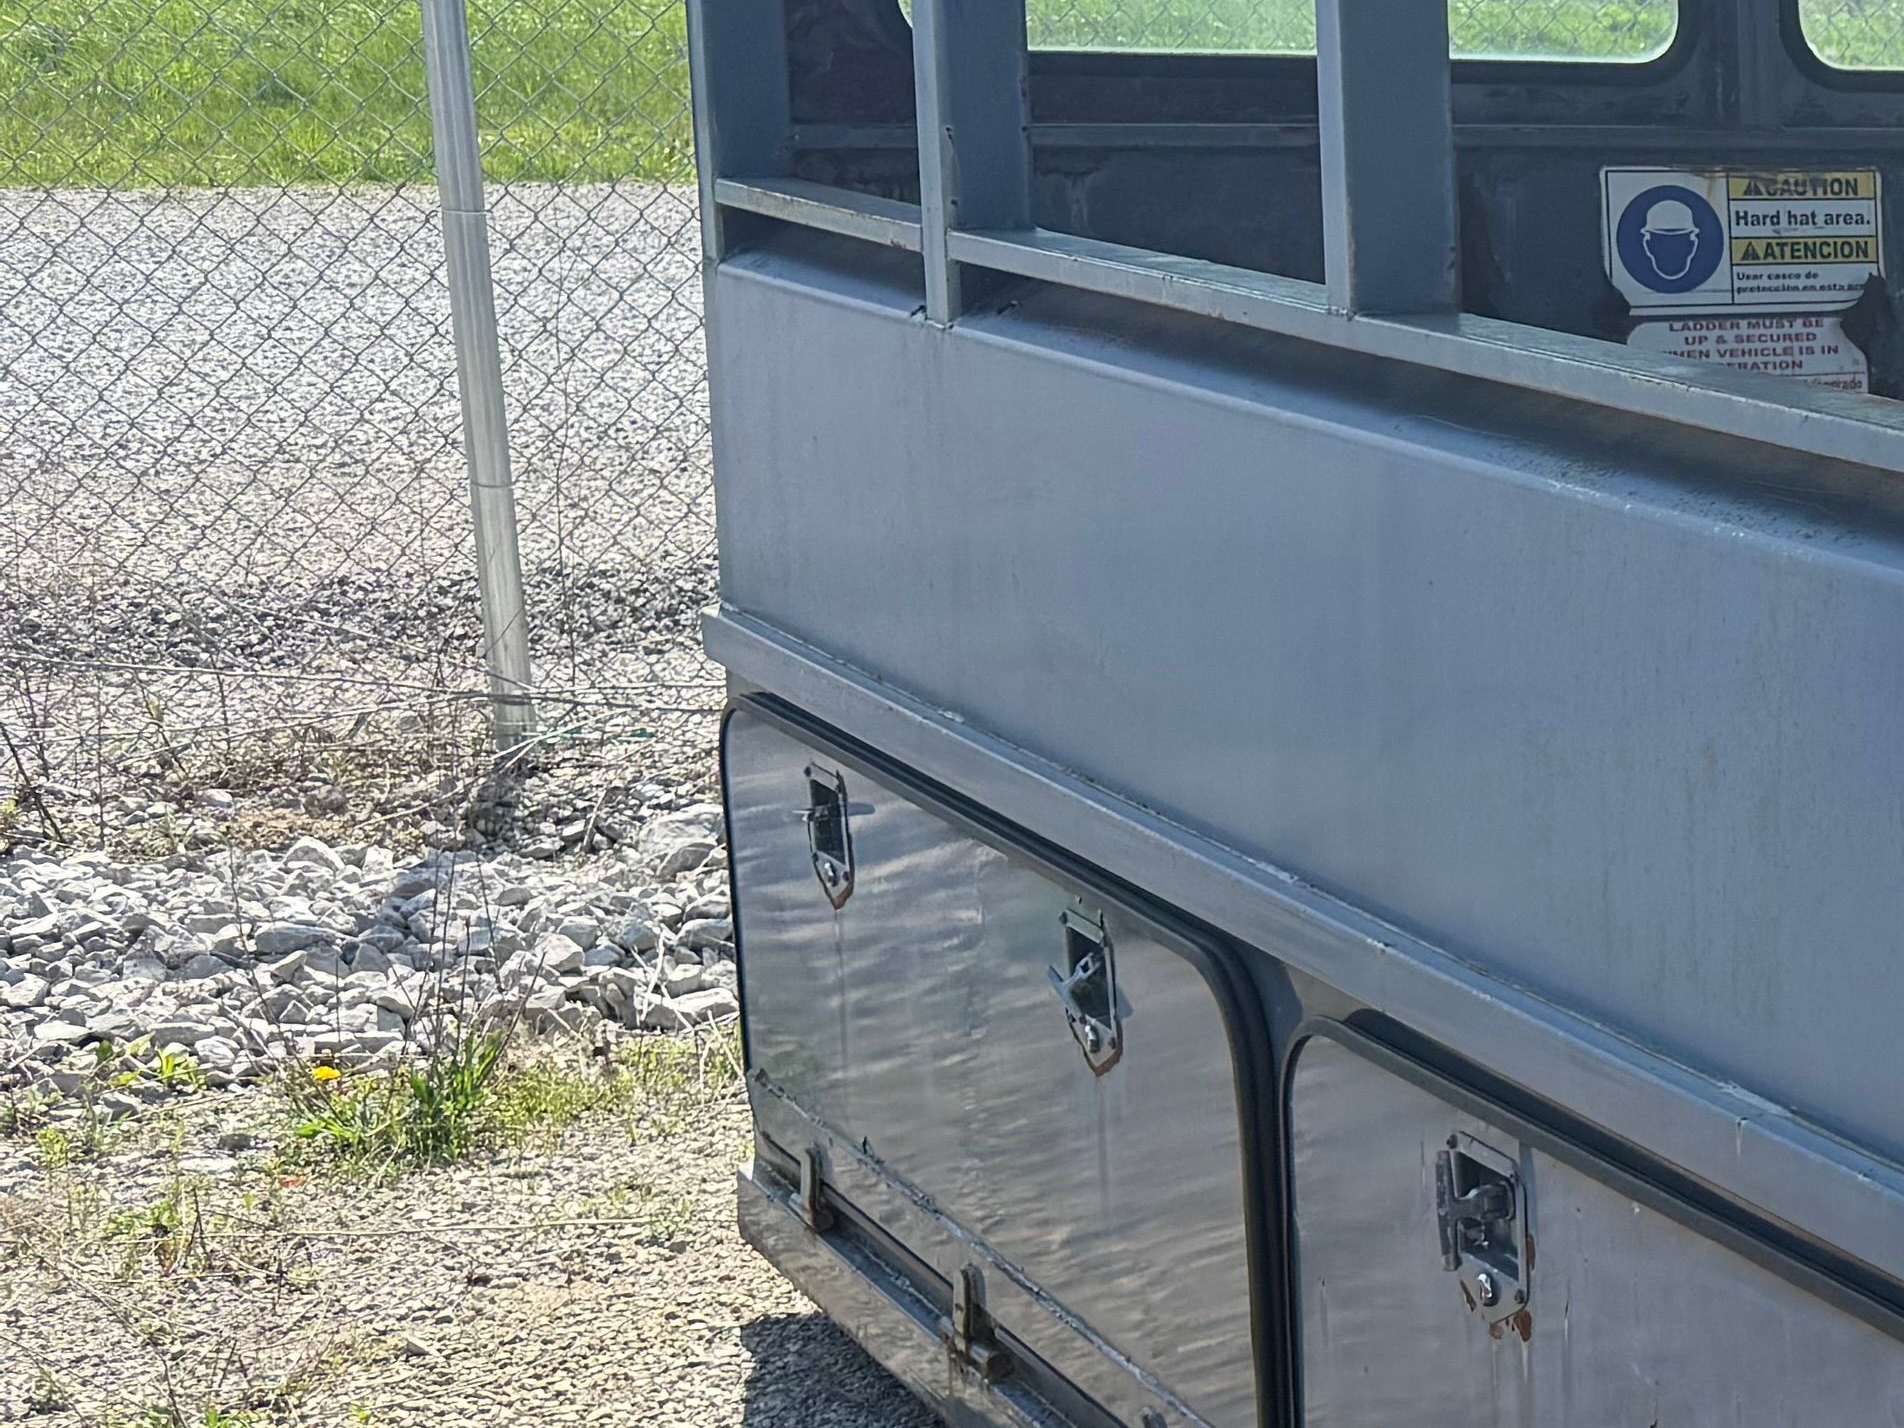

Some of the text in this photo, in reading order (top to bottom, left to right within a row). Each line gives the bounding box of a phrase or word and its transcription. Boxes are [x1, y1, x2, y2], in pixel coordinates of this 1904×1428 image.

[1765, 178, 1858, 197] CAUTION
[1735, 210, 1870, 226] Hard hat area.
[1763, 241, 1869, 260] ATENCION
[1736, 272, 1763, 281] Usar
[1804, 271, 1819, 280] de
[1669, 318, 1824, 332] LADDER MUST BE
[1685, 332, 1817, 346] UP & SECURED
[1660, 344, 1839, 360] HEN VEHICLE IS IN
